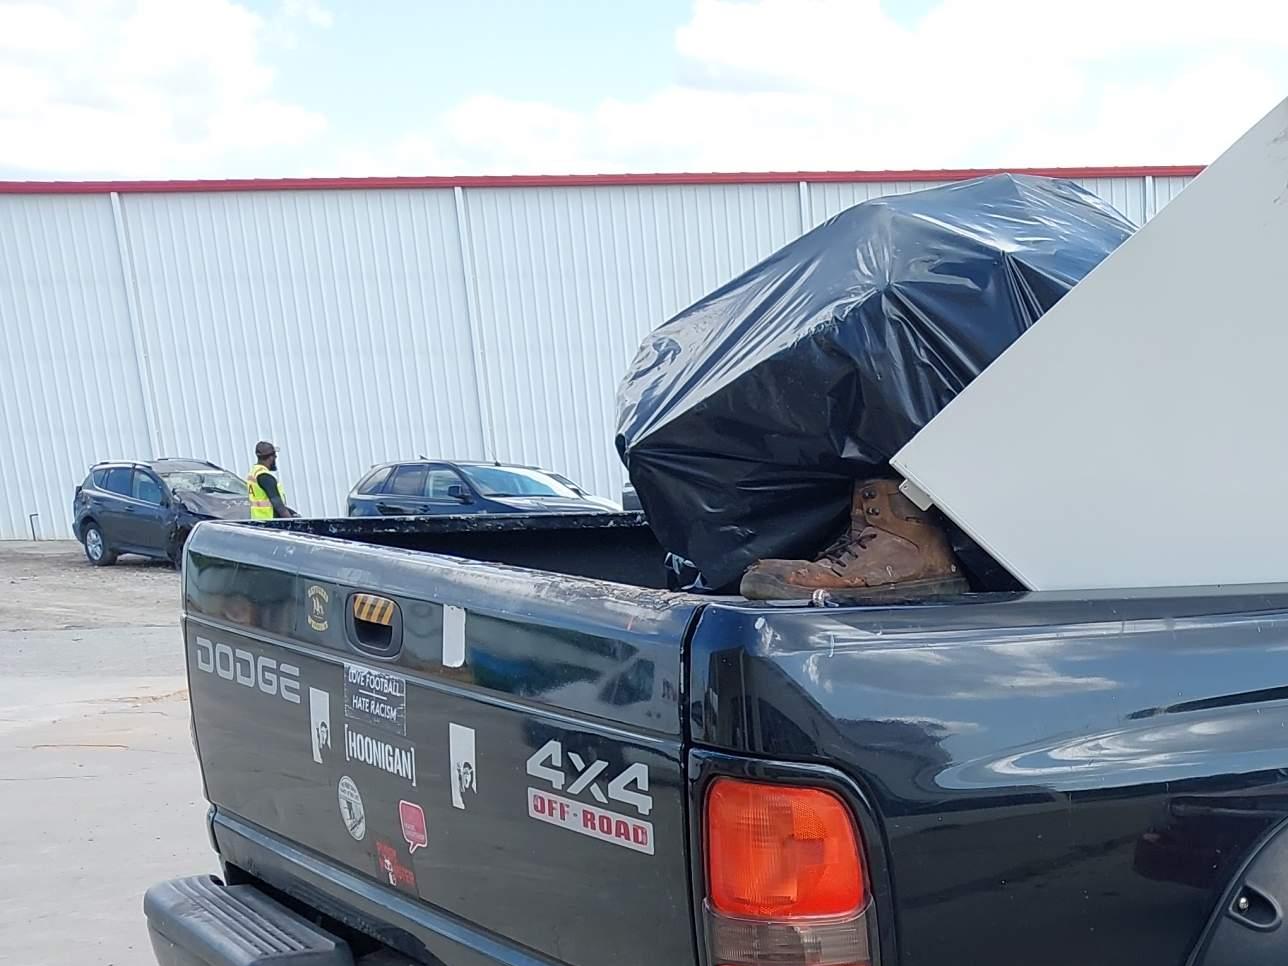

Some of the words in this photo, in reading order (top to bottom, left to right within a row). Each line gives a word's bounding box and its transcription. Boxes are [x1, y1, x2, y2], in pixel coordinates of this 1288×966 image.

[196, 636, 300, 704] DODGE
[348, 668, 365, 686] LOVE
[366, 673, 400, 696] FOOTBALL
[352, 695, 369, 713] HATE
[370, 700, 397, 721] RACISM
